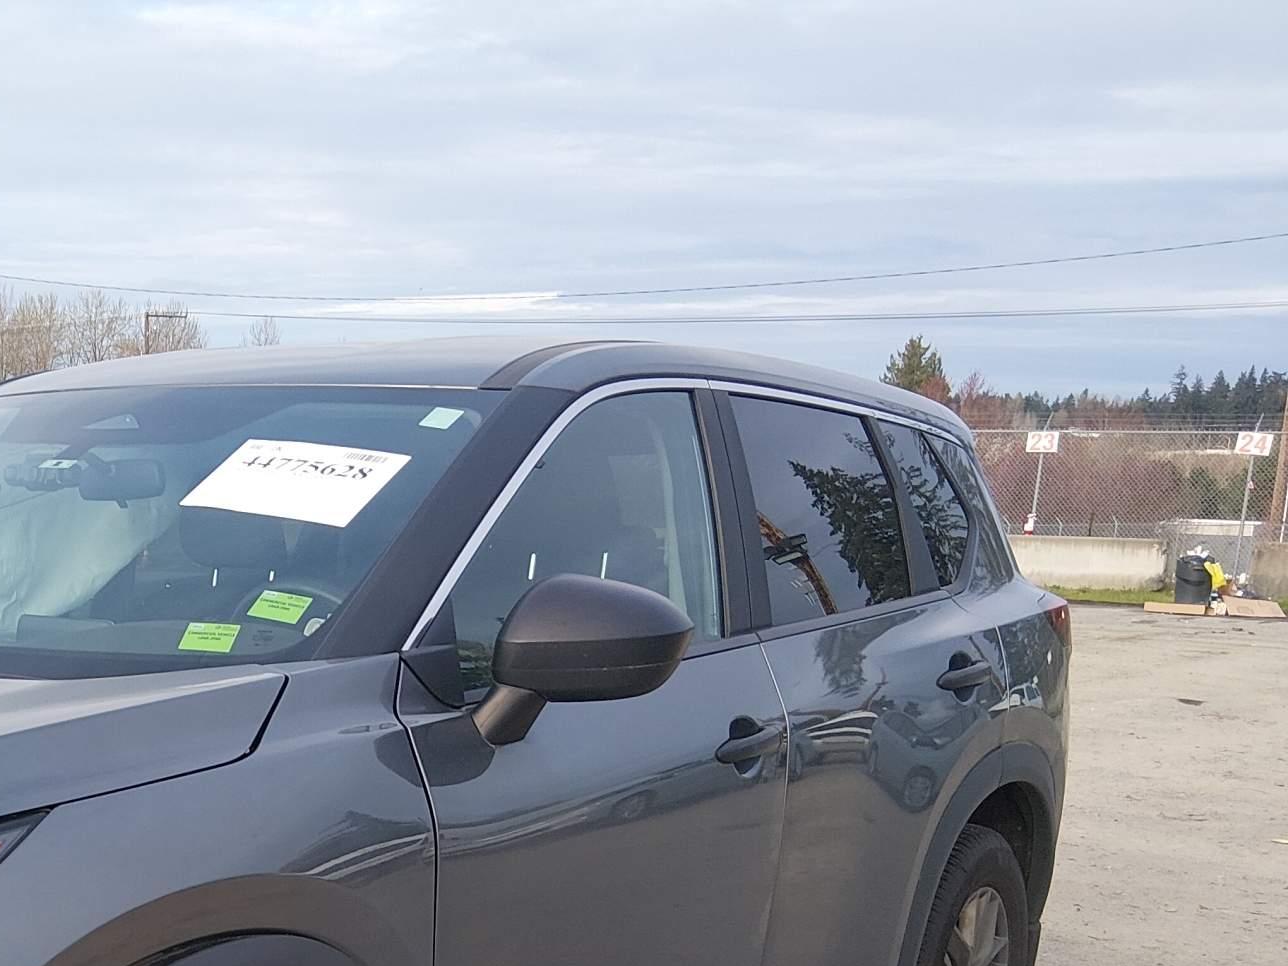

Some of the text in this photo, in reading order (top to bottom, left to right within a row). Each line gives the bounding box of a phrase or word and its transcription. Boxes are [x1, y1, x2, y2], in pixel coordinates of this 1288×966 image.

[1030, 433, 1055, 450] 23
[1239, 433, 1268, 453] 24
[242, 456, 373, 480] 44775628
